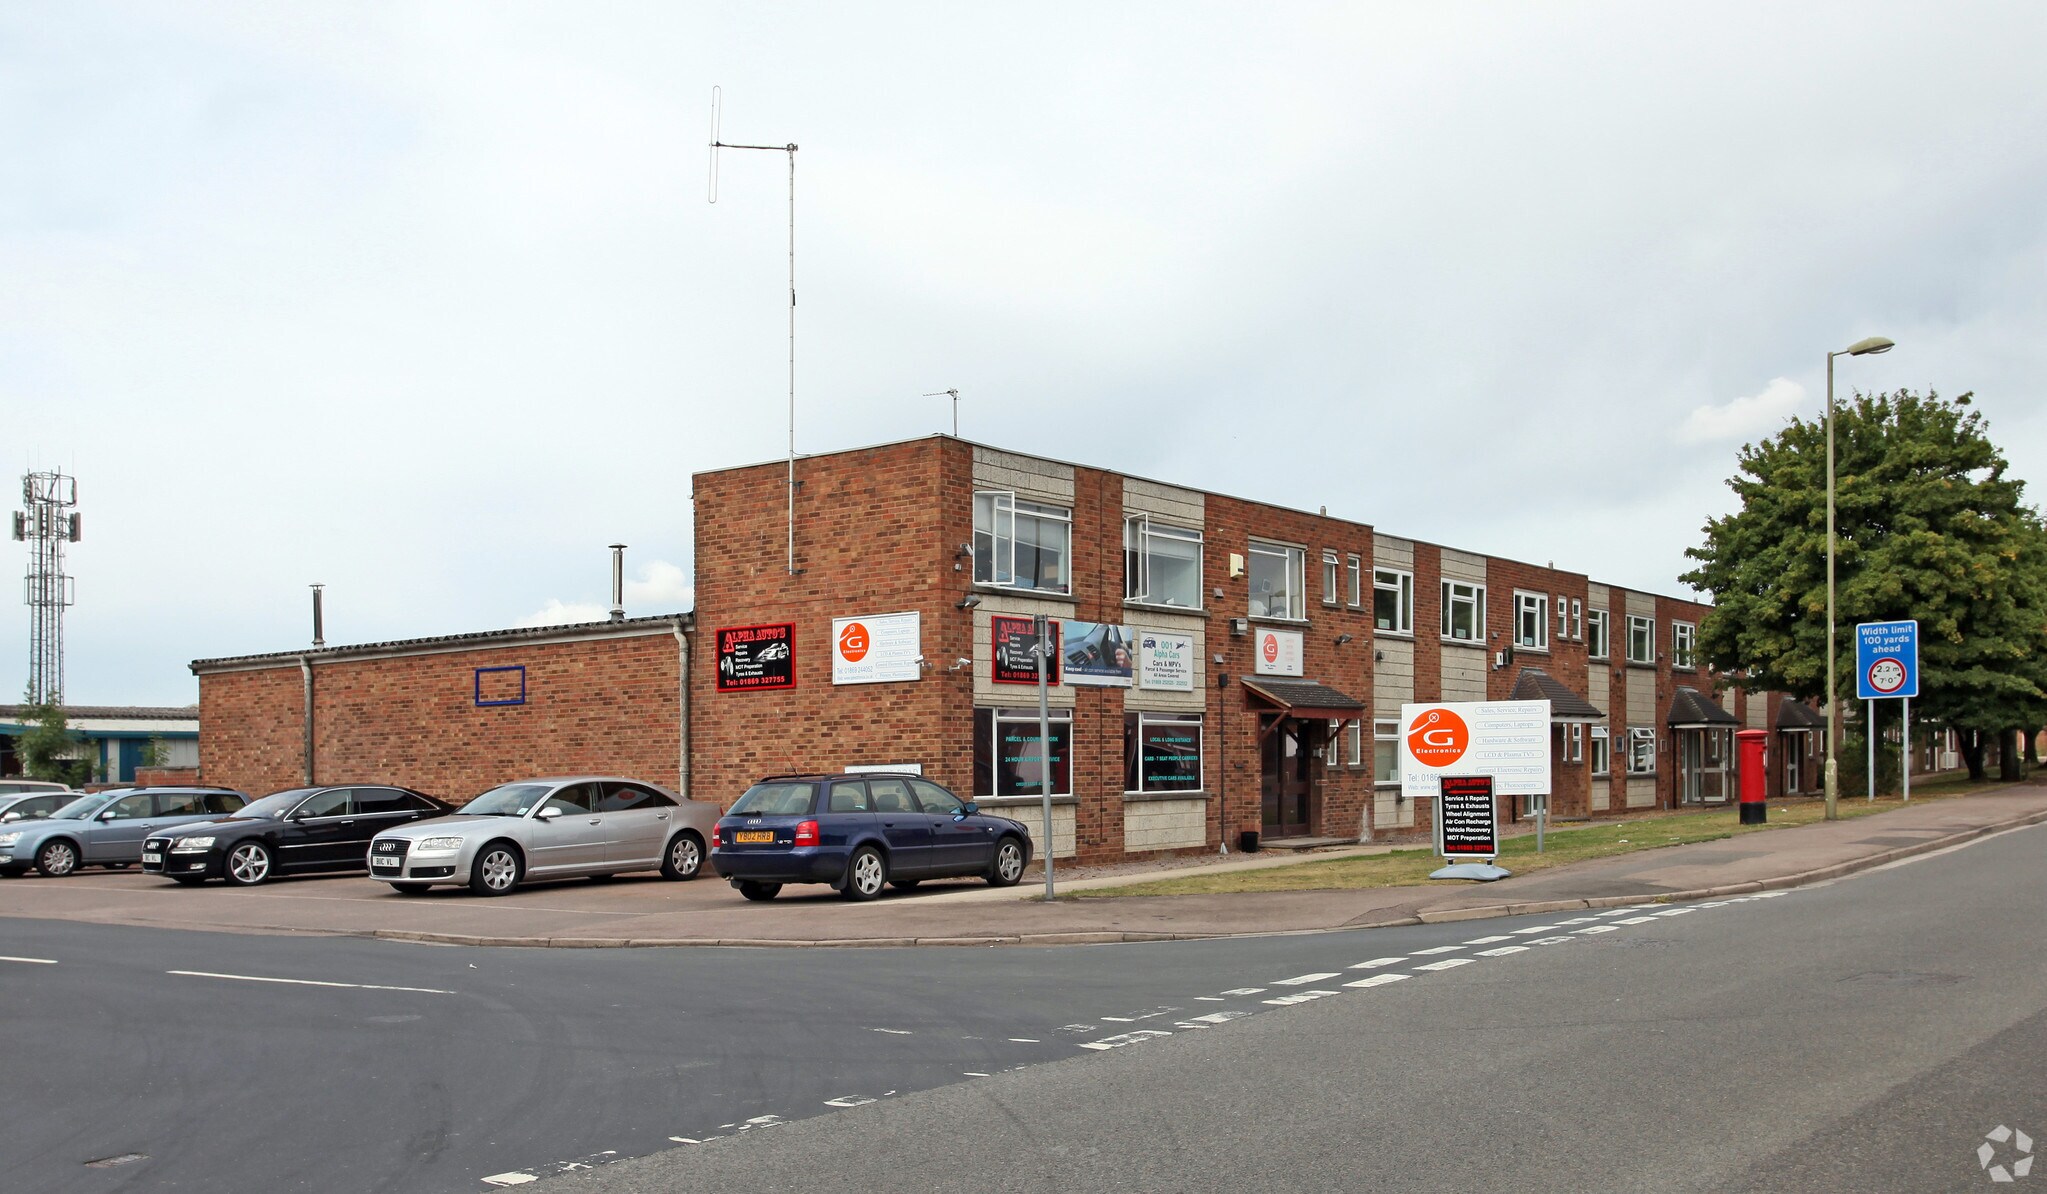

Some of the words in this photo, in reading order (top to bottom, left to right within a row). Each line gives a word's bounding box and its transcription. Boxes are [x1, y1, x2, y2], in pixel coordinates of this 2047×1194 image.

[999, 621, 1026, 642] ALPHA
[1862, 626, 1888, 636] Width
[1891, 625, 1912, 634] limit
[722, 629, 755, 653] ALPHA
[756, 627, 786, 641] AUTO'S
[846, 636, 863, 649] G
[1864, 636, 1881, 644] 100
[1884, 634, 1910, 645] yards
[1161, 641, 1173, 649] 001
[1266, 643, 1275, 653] G
[1872, 645, 1901, 654] ahead
[1154, 650, 1168, 659] Alpha
[1168, 651, 1180, 659] Cars
[761, 675, 785, 684] 327755
[1514, 721, 1534, 729] Laptops
[1423, 729, 1454, 746] G
[1408, 773, 1420, 782] Tel:
[1443, 778, 1467, 789] ALPHA
[1504, 781, 1536, 789] Photocopiers
